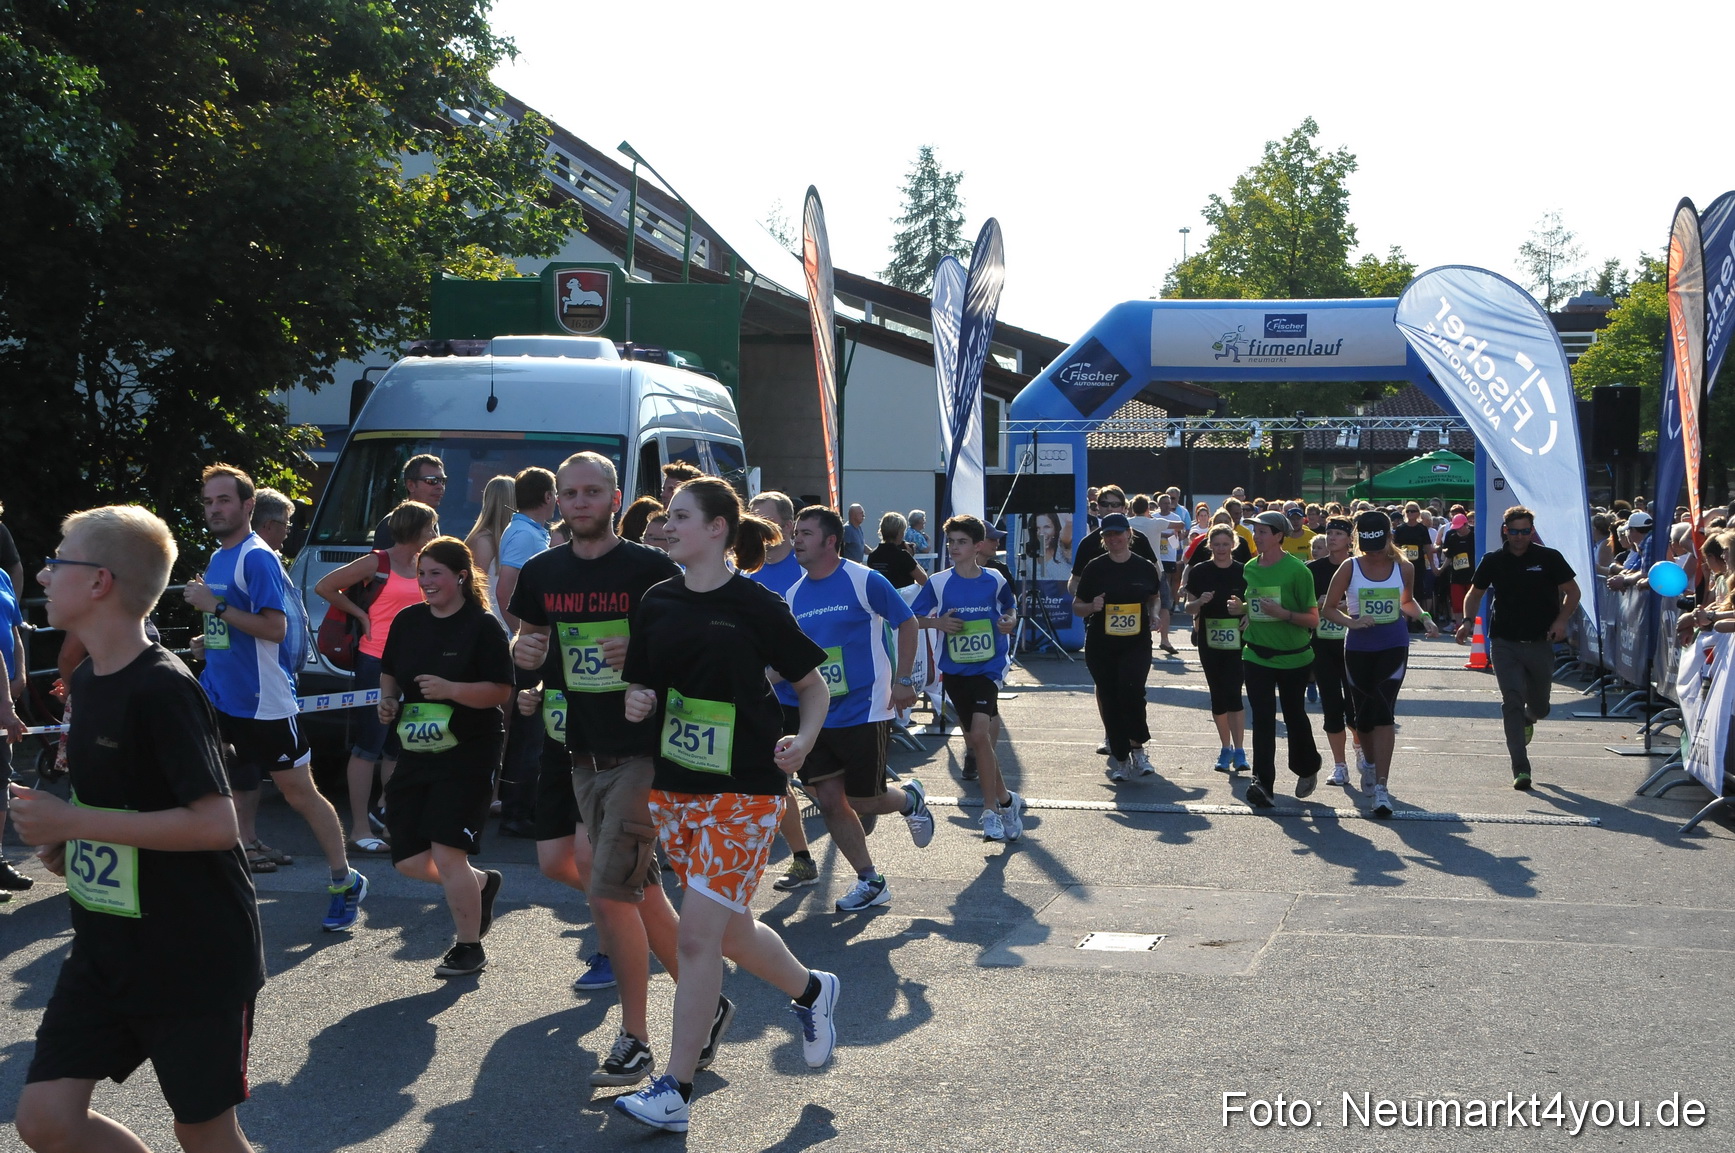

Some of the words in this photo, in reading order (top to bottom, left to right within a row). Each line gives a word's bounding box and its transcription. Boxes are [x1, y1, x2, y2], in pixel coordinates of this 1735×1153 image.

[571, 319, 595, 329] 1628
[1273, 322, 1305, 330] Fischer
[1248, 338, 1343, 356] firmenlauf
[1069, 370, 1119, 381] Fischer
[543, 592, 585, 613] MANU
[589, 592, 630, 613] CHAO
[1365, 600, 1394, 615] 596
[1110, 614, 1136, 628] 236
[949, 633, 992, 653] 1260
[1210, 629, 1235, 642] 256
[404, 722, 444, 743] 240
[668, 717, 715, 755] 251
[71, 840, 120, 888] 252
